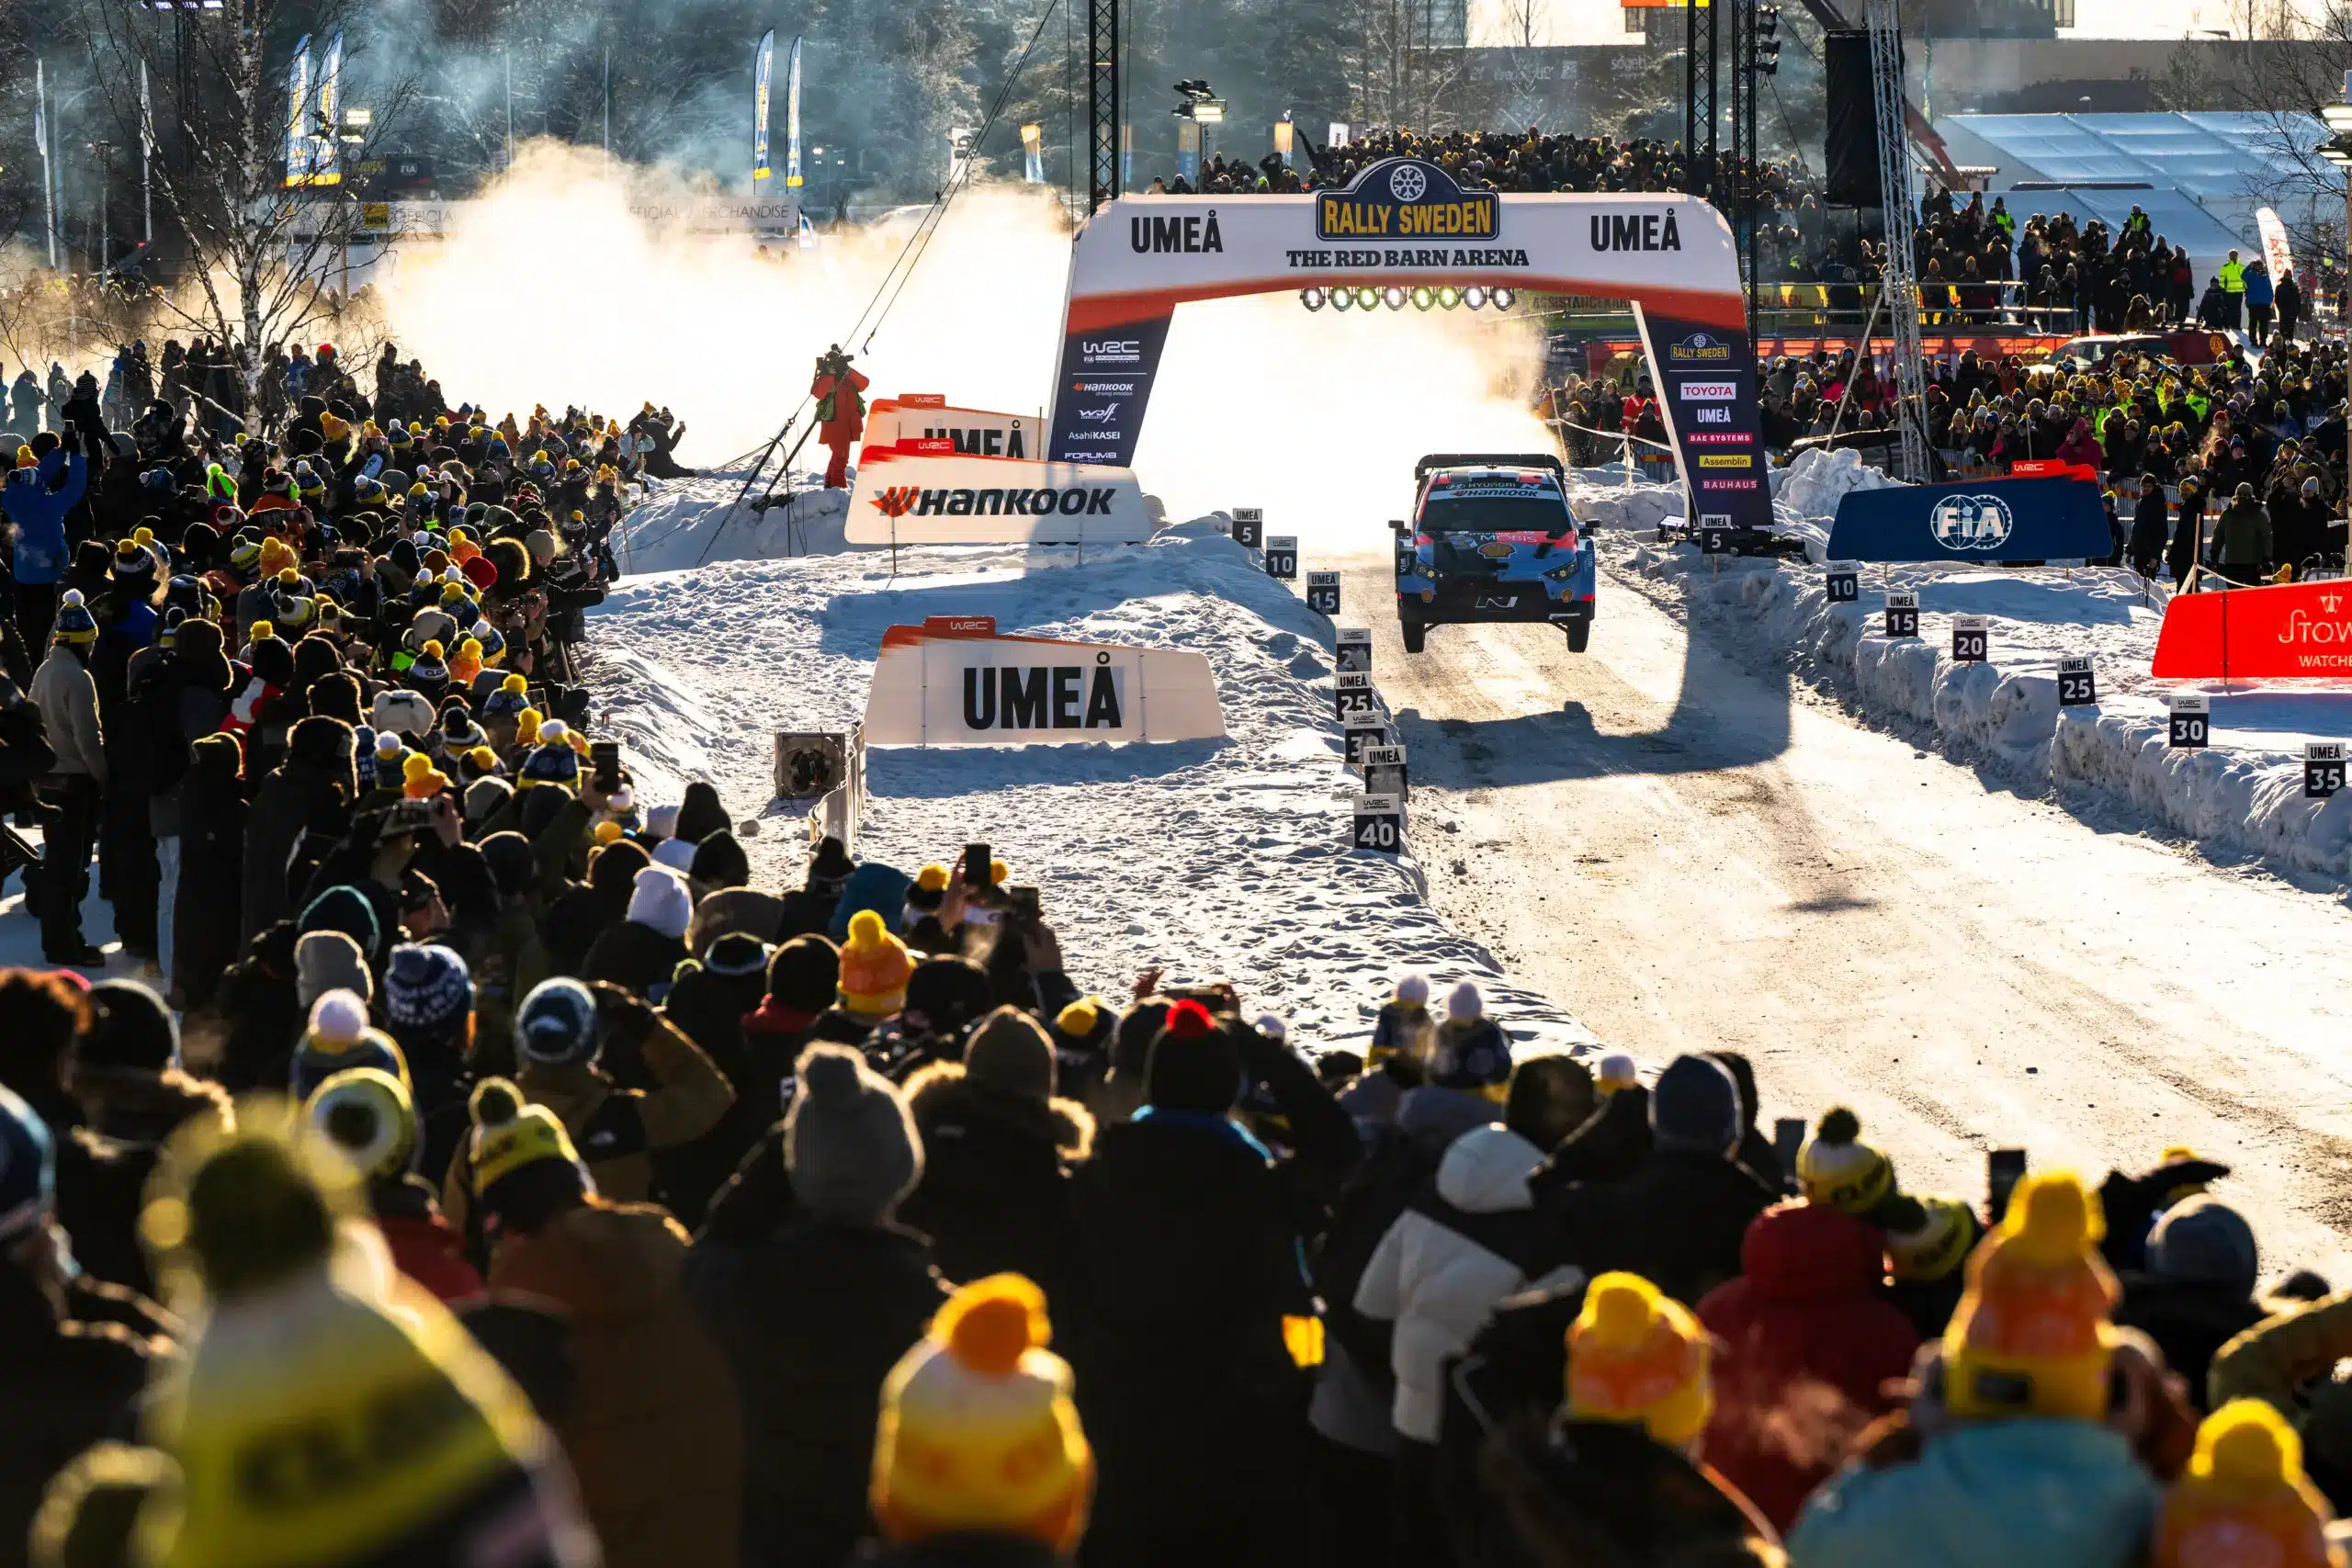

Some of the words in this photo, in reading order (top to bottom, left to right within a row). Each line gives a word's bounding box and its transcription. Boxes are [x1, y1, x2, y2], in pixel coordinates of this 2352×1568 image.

[1324, 199, 1392, 233] RALLY
[1398, 198, 1491, 234] SWEDEN
[1131, 209, 1224, 254] UMEÅ
[1590, 208, 1681, 252] UMEÅ
[1286, 250, 1332, 267] THE
[1335, 250, 1385, 267] RED
[1385, 249, 1449, 266] BARN
[1452, 249, 1530, 266] ARENA
[1083, 341, 1139, 353] WRC
[1673, 346, 1694, 358] RALLY
[1696, 346, 1727, 358] SWEDEN
[1684, 387, 1733, 397] TOYOTA
[1697, 406, 1731, 423] UMEÅ
[1703, 457, 1747, 467] Assemblin
[1703, 480, 1757, 489] BAUHAUS
[1237, 509, 1259, 521] UMEÅ
[1705, 516, 1727, 527] UMEÅ
[1242, 526, 1252, 543] 5
[1480, 535, 1537, 543] MOBIS
[1712, 533, 1721, 549] 5
[1271, 556, 1294, 572] 10
[1311, 573, 1336, 585] UMEÅ
[1831, 580, 1854, 596] 10
[1312, 592, 1336, 609] 15
[1890, 594, 1915, 607] UMEÅ
[950, 621, 989, 630] WRC
[1890, 615, 1915, 631] 15
[1958, 637, 1983, 656] 20
[2062, 658, 2088, 672] UMEÅ
[1340, 674, 1367, 687] UMEÅ
[963, 651, 1123, 730] UMEÅ
[2064, 680, 2091, 699] 25
[1340, 695, 1368, 714] 25
[2175, 720, 2203, 741] 30
[1369, 748, 1401, 763] UMEÅ
[2310, 745, 2340, 760] UMEÅ
[2311, 769, 2341, 791] 35
[1359, 822, 1395, 847] 40
